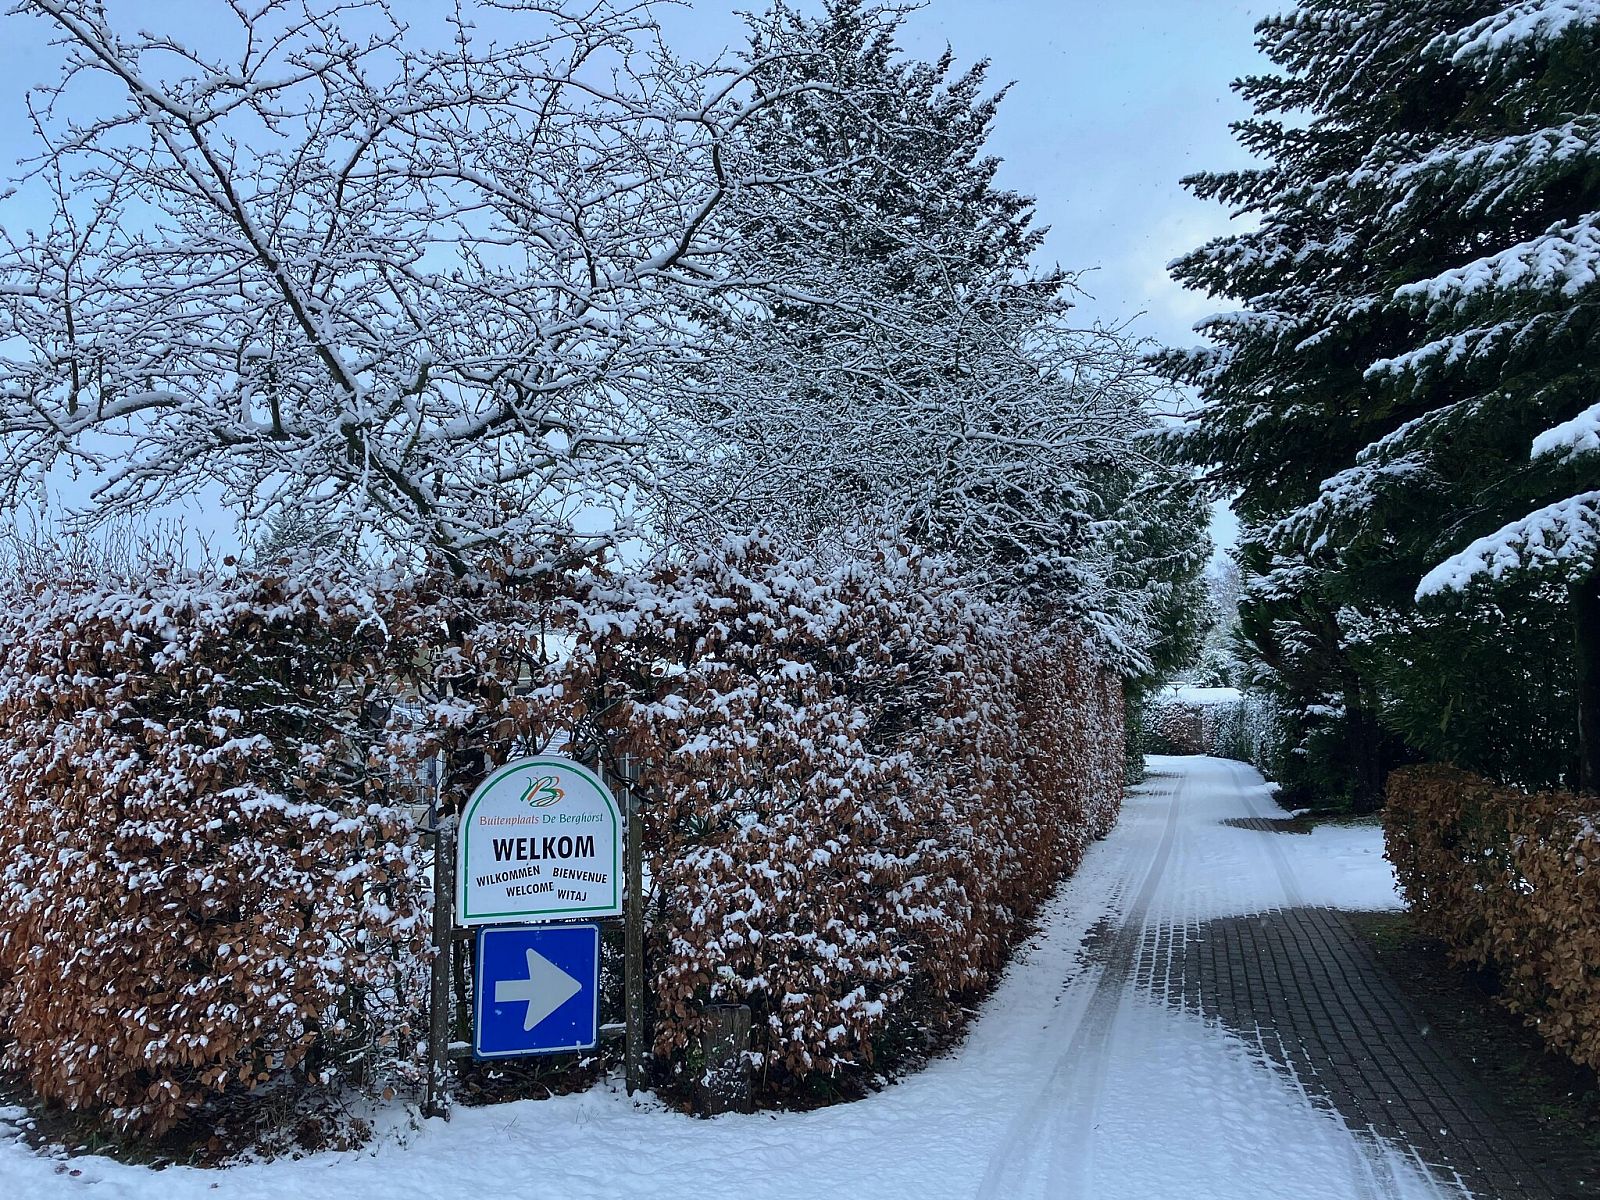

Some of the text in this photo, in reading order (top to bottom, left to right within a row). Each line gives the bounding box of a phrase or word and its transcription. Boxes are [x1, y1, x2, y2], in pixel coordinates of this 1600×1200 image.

[480, 812, 603, 826] Buitenplaats De Berghorst
[492, 835, 595, 862] WELKOM
[476, 865, 608, 887] WILKOMMEN BIENVENUE
[506, 881, 587, 902] WELCOME WITAJ
